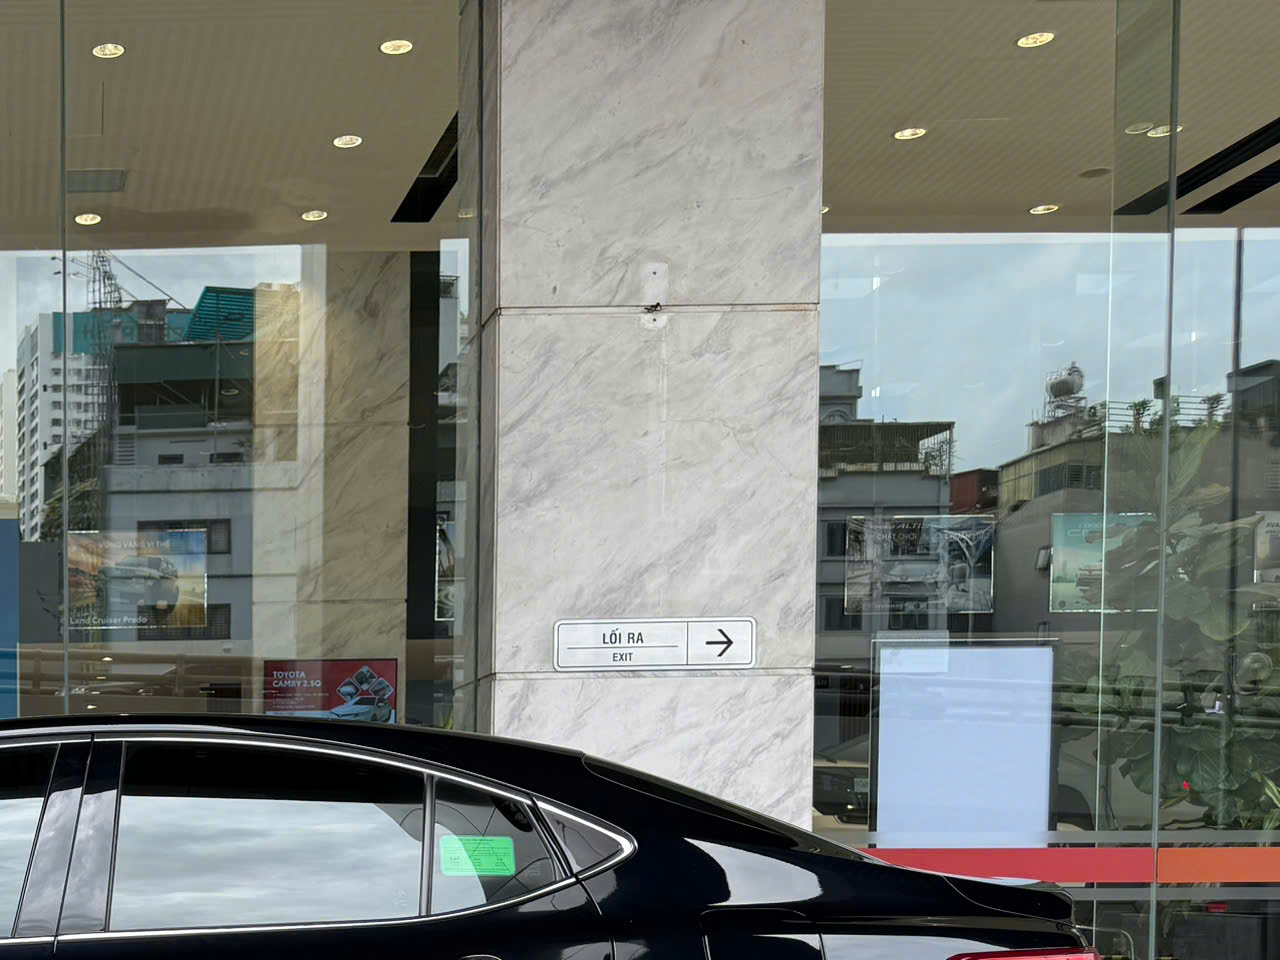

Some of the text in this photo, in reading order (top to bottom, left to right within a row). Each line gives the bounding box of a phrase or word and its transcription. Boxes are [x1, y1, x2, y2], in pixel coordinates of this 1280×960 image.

[69, 615, 148, 625] Land Cruiser Prado
[602, 628, 644, 645] LỐI RA
[612, 652, 633, 662] EXIT
[272, 671, 306, 679] TOYOTA
[272, 680, 303, 688] CAMRY
